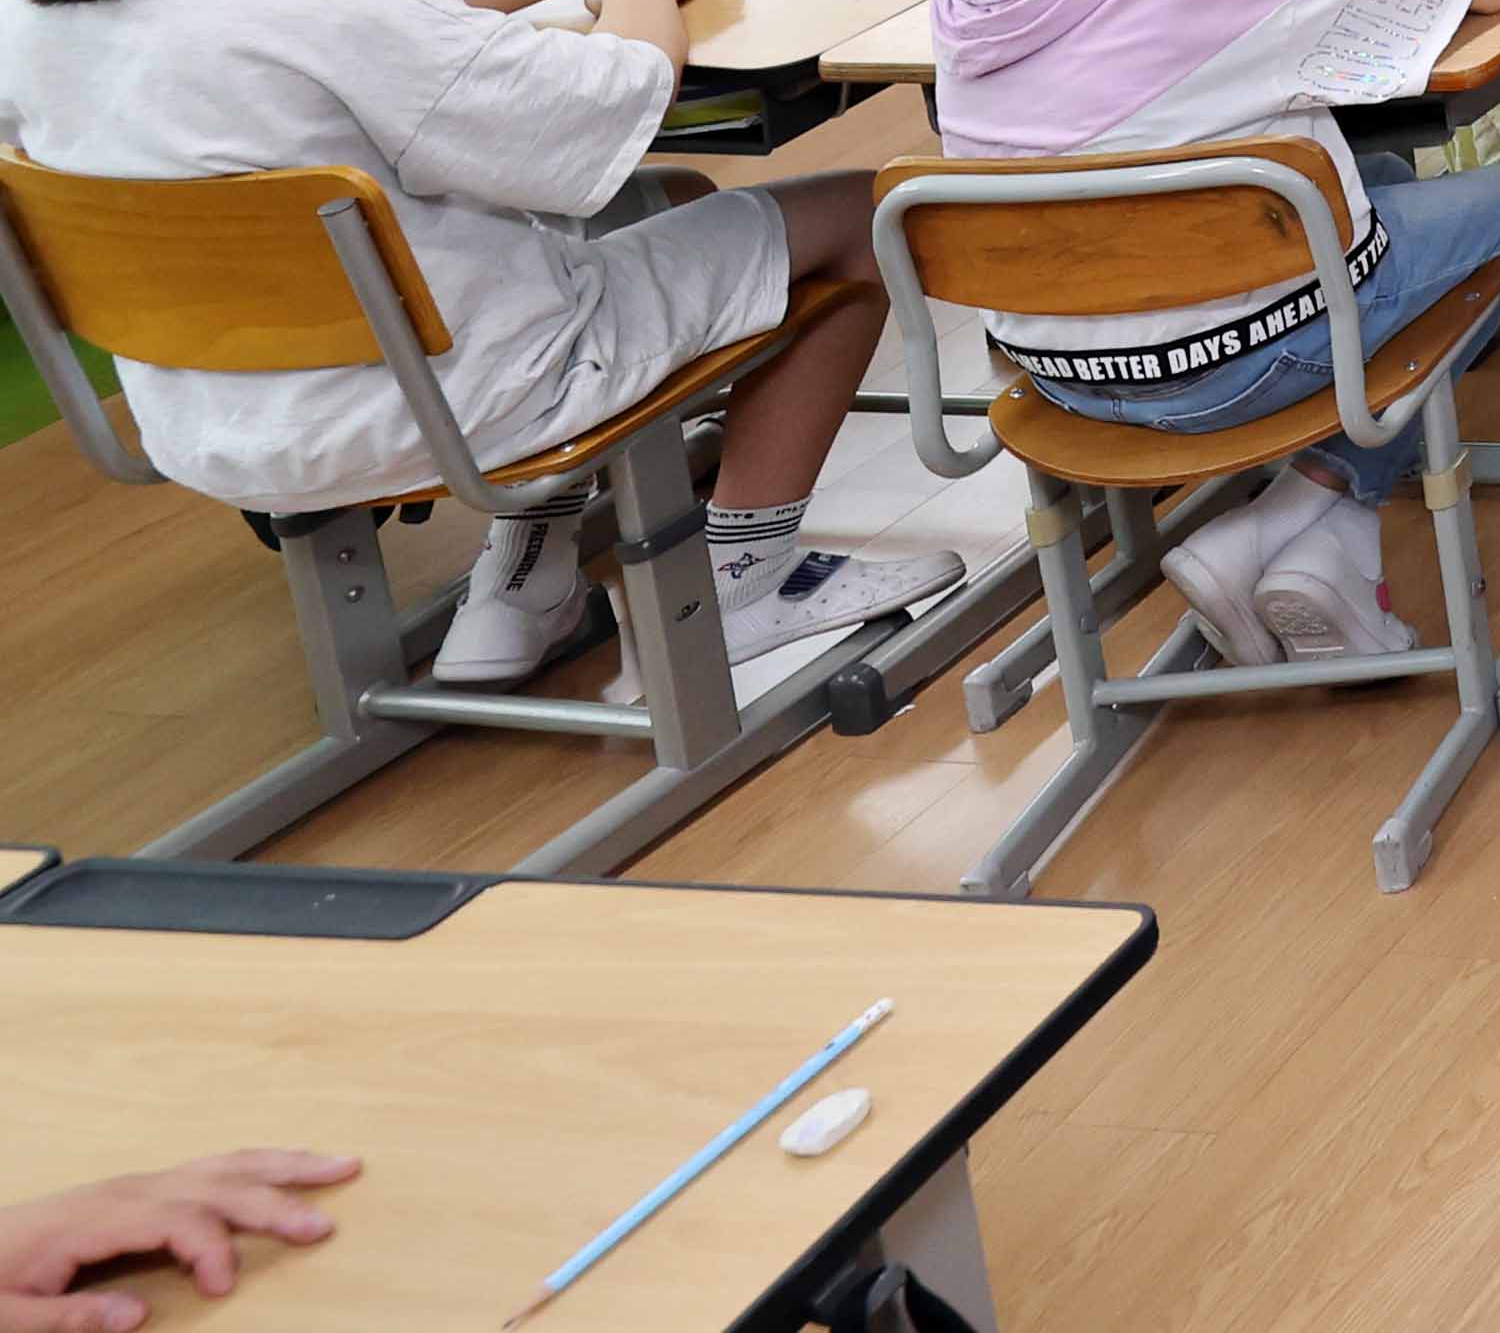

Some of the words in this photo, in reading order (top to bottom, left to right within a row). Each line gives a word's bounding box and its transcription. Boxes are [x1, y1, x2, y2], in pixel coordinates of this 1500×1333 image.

[1073, 354, 1162, 382] BETTER
[1167, 329, 1242, 375] DAYS
[1348, 221, 1390, 287] ETTER
